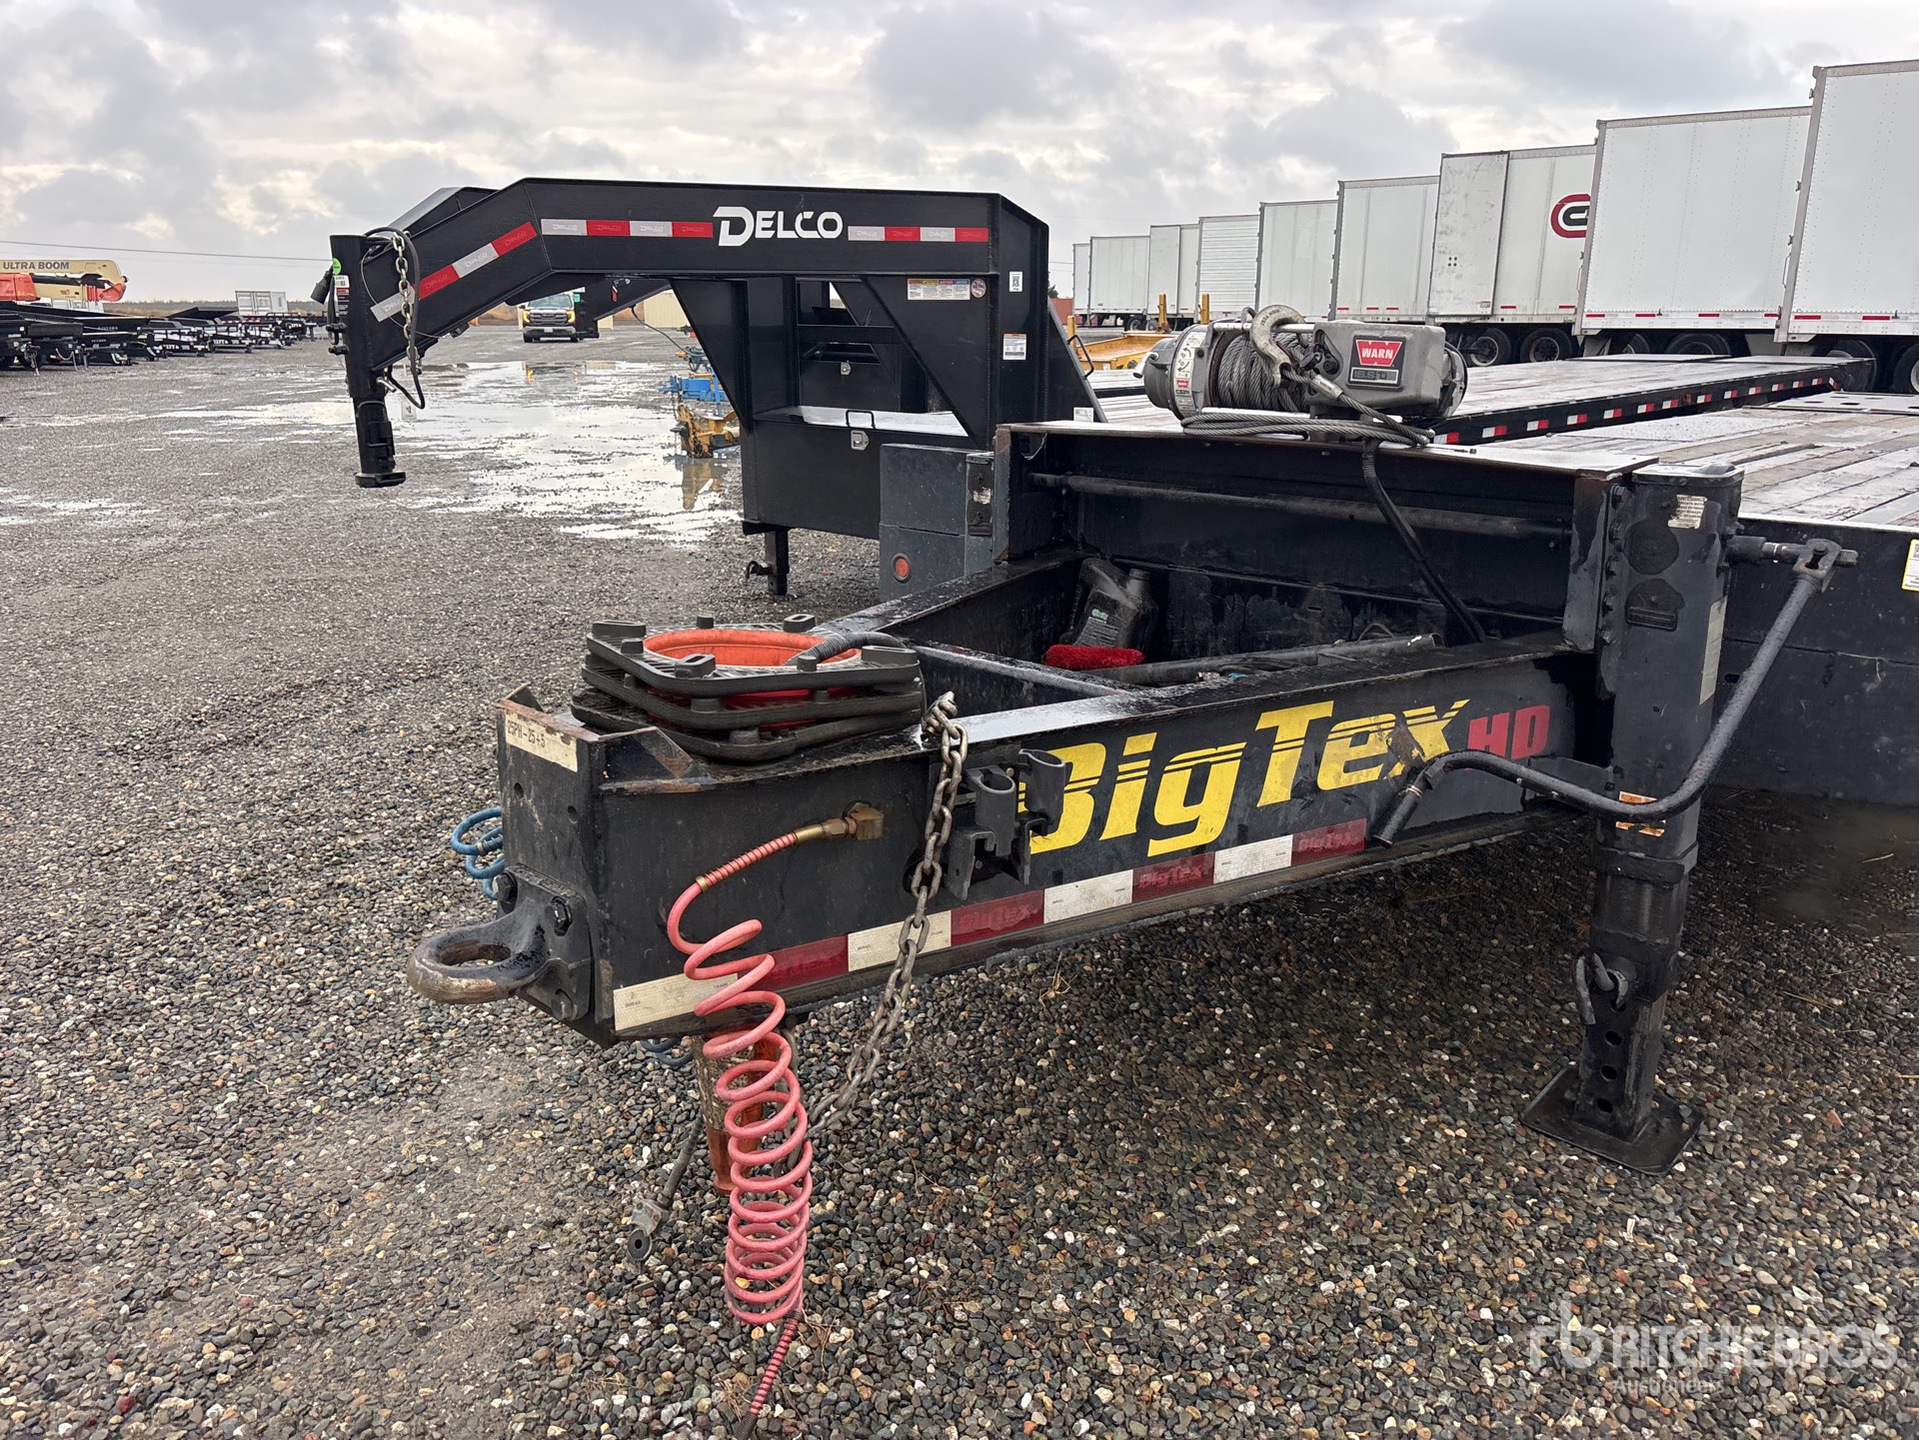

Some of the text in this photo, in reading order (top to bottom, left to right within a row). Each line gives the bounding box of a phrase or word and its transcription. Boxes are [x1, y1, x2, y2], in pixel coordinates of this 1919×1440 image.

[713, 206, 843, 247] DELCO
[3, 261, 70, 270] ULTRA BOOM
[1362, 347, 1394, 360] WARN
[1467, 704, 1551, 761] HD
